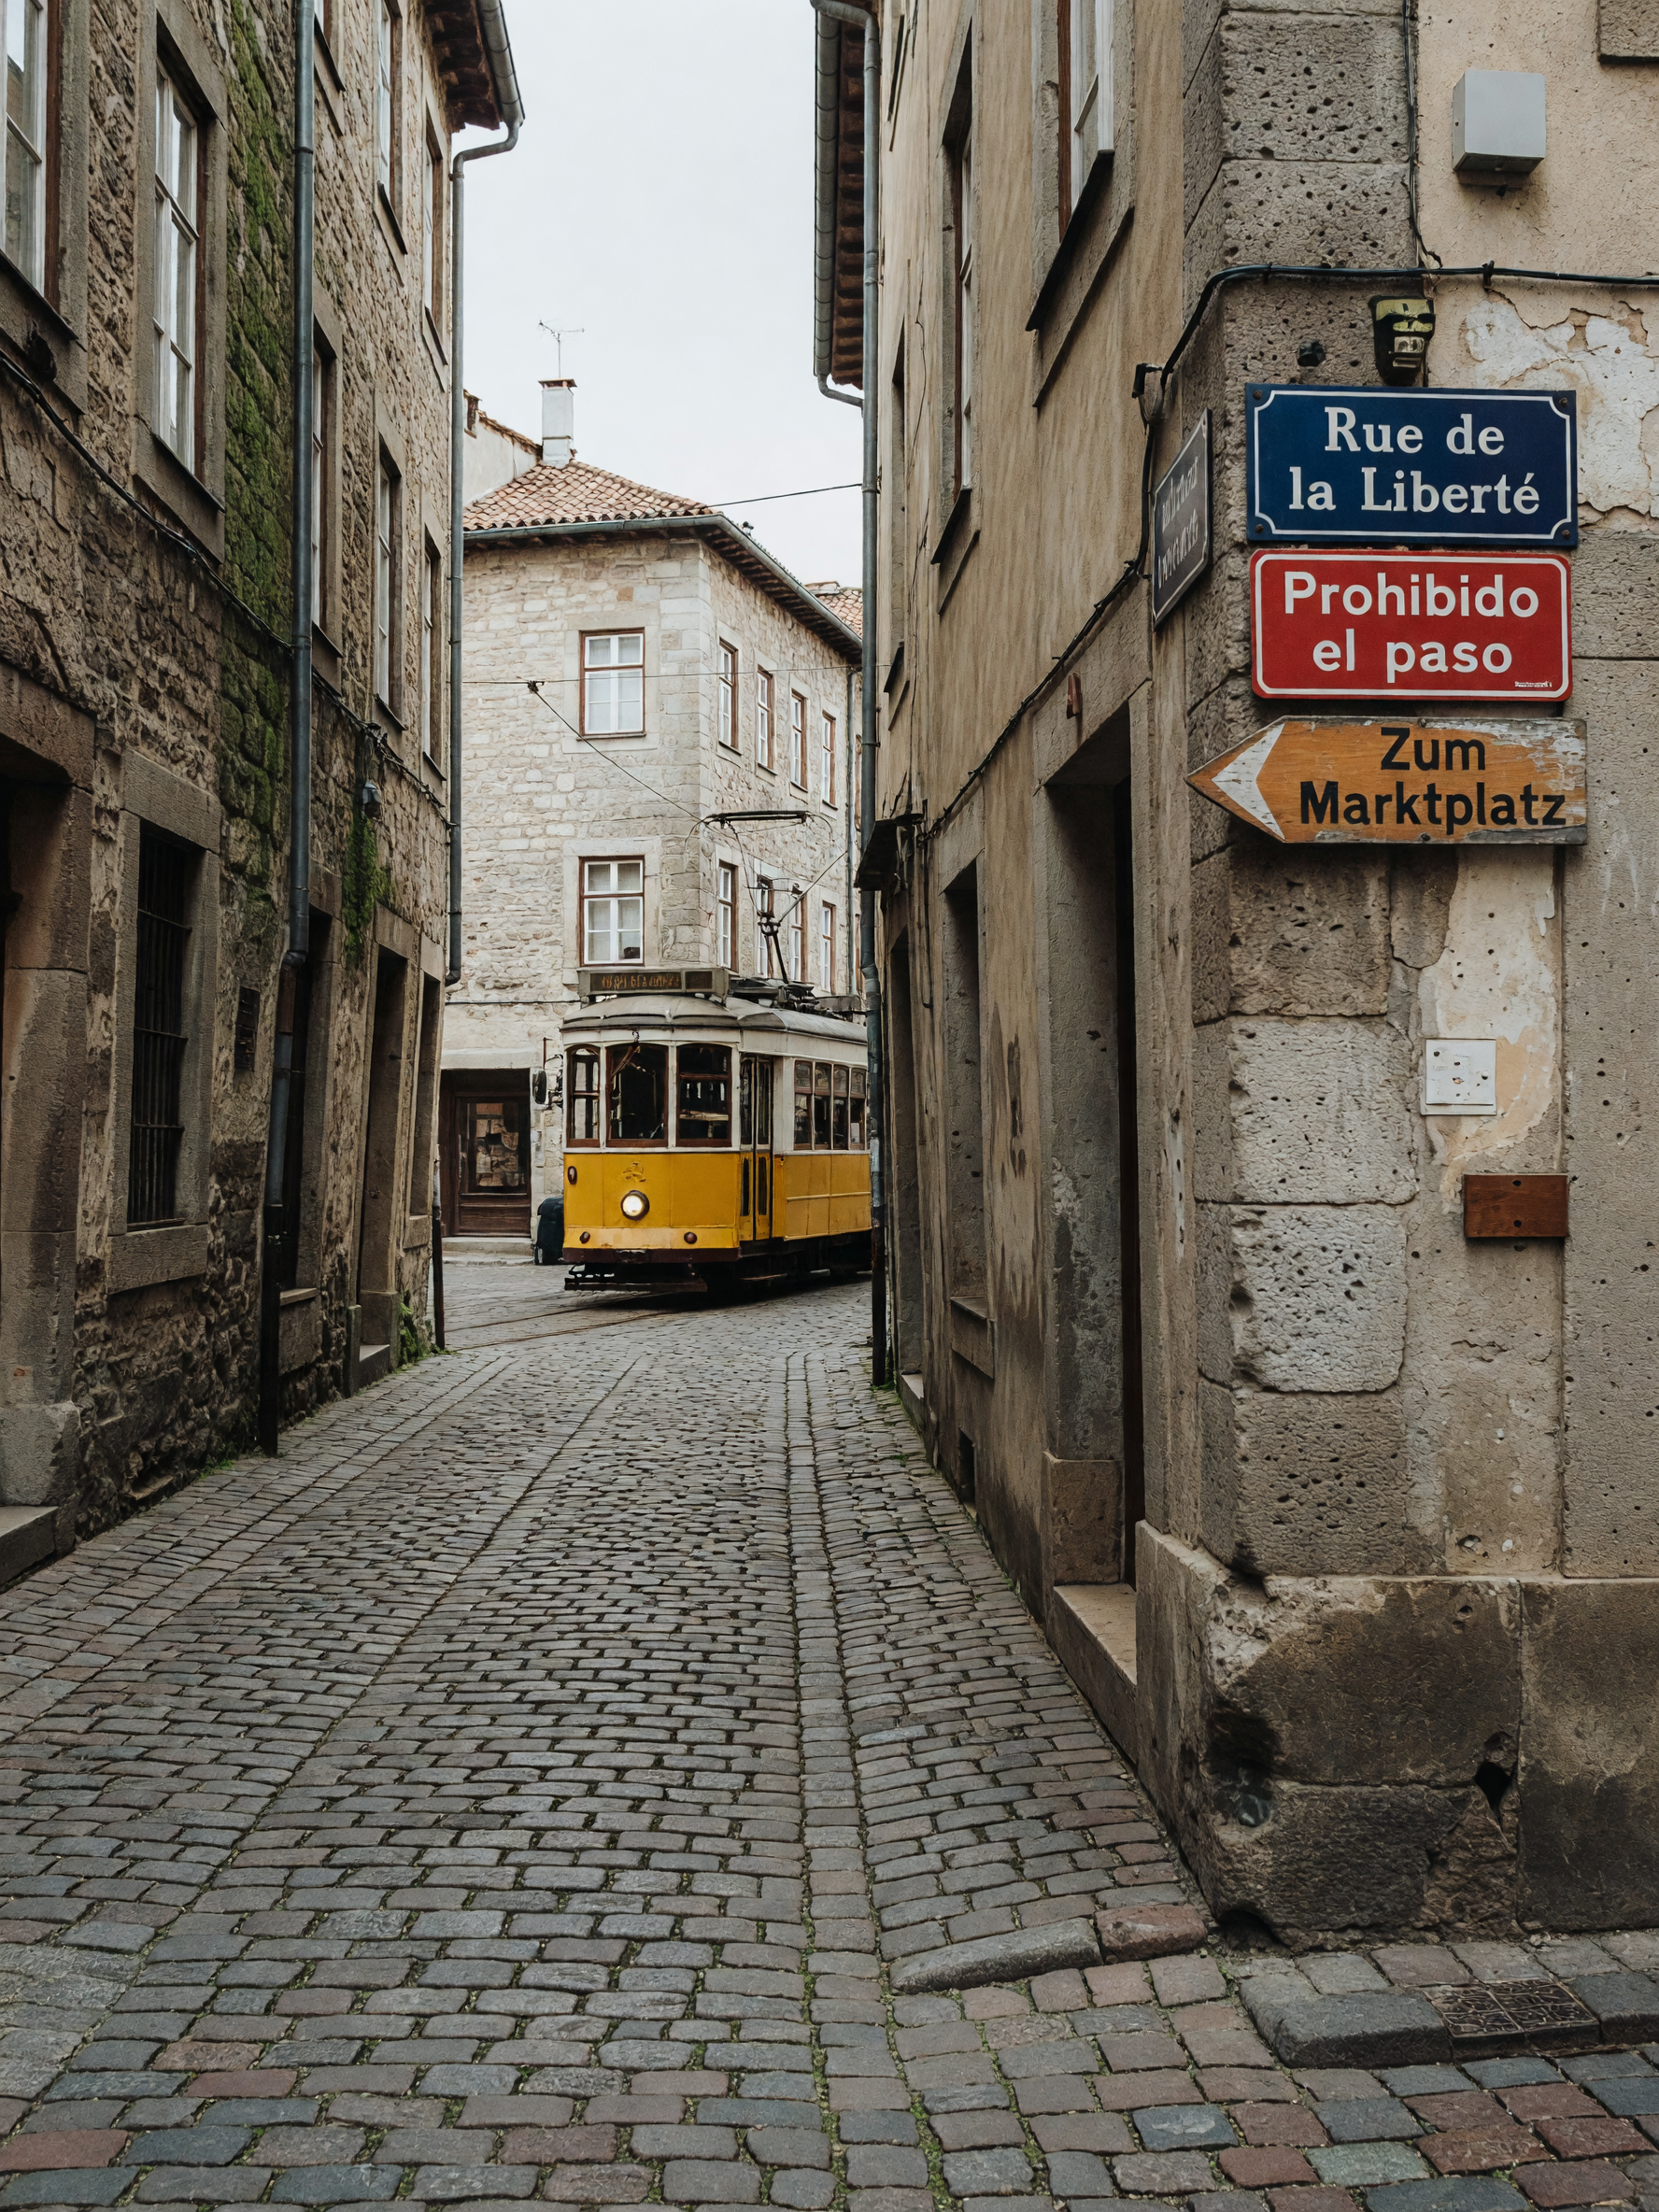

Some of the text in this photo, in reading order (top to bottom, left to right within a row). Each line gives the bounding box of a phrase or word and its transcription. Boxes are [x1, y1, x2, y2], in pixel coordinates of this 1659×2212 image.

[1325, 407, 1505, 456] Rue de
[1289, 467, 1539, 515] la Liberté
[1284, 572, 1539, 617] Prohibido
[1313, 629, 1511, 684] el paso
[1381, 727, 1485, 771] Zum
[1300, 781, 1567, 835] Marktplatz
